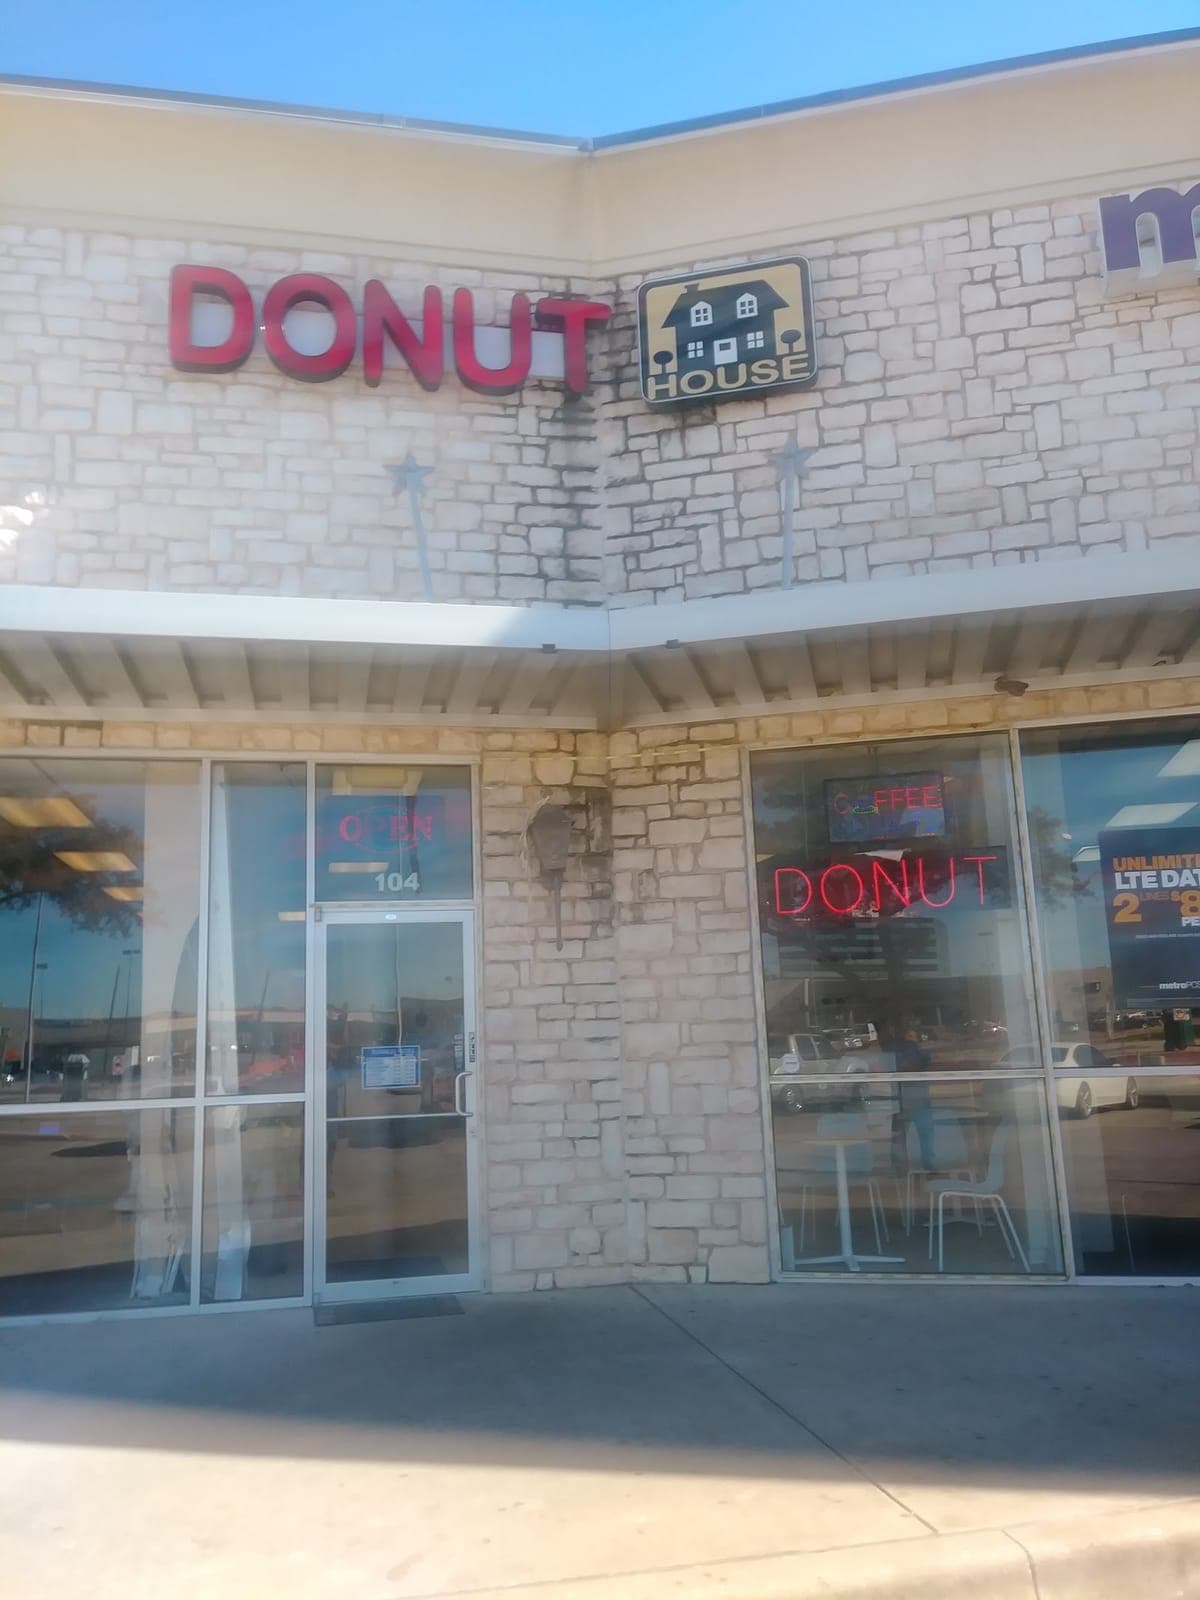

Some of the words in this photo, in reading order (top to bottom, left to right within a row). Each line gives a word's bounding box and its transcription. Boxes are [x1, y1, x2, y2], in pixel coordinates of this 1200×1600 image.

[168, 264, 613, 396] DONUT
[647, 353, 811, 400] HOUSE
[338, 815, 433, 843] OPEN
[374, 872, 420, 892] 104
[775, 856, 998, 915] DONUT
[1114, 871, 1159, 890] LTE
[1112, 892, 1142, 923] 2
